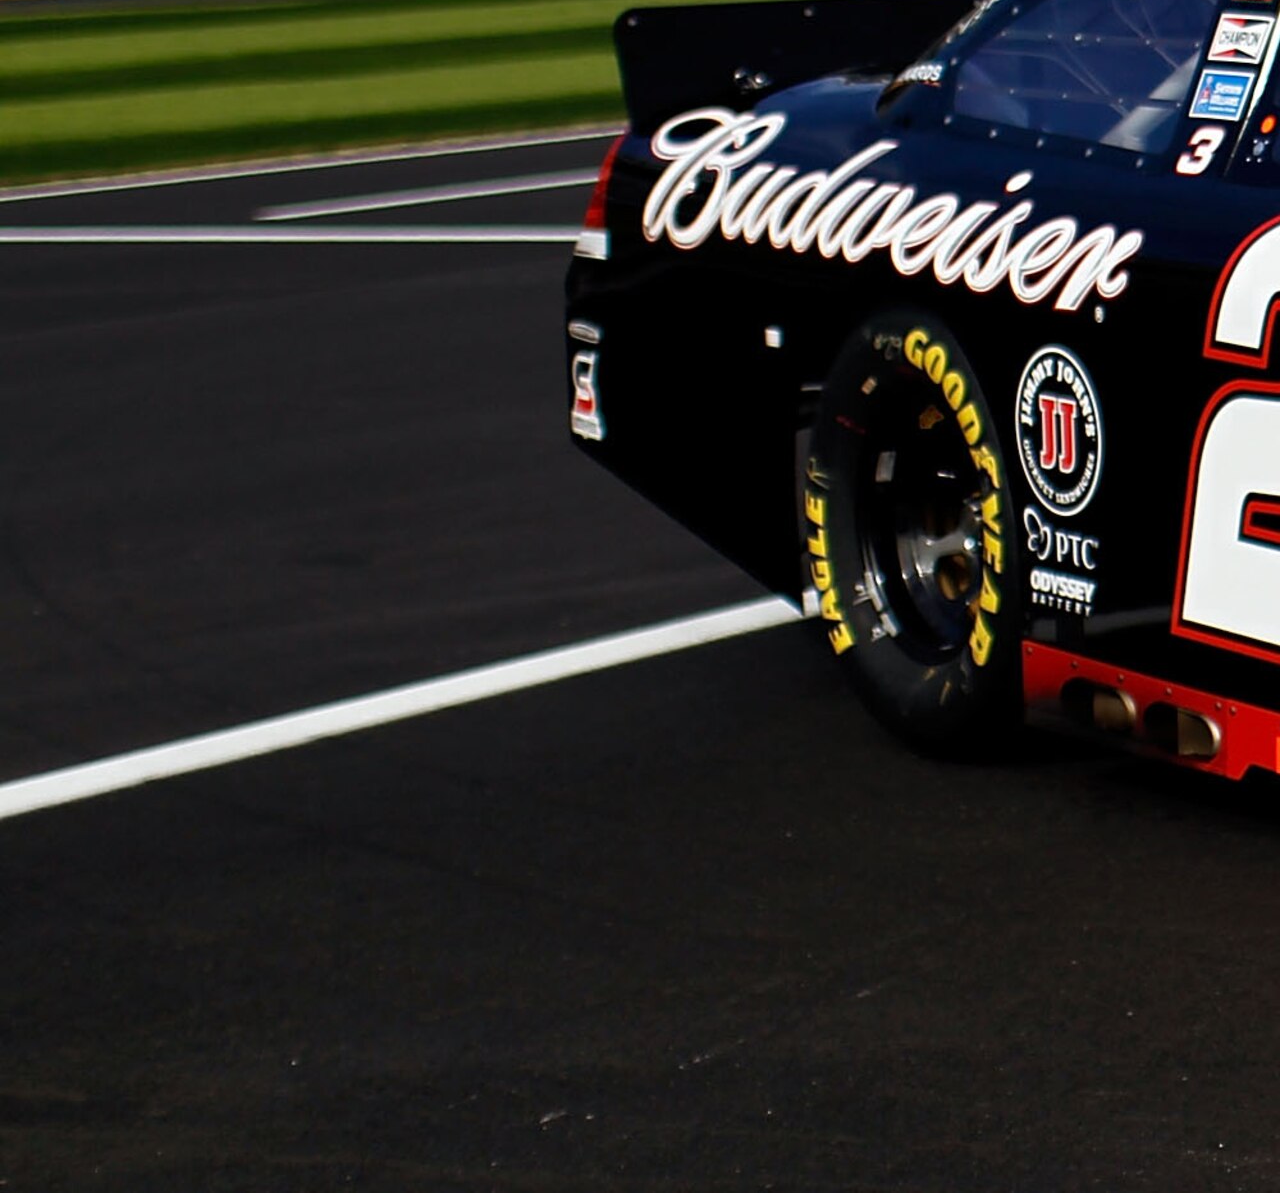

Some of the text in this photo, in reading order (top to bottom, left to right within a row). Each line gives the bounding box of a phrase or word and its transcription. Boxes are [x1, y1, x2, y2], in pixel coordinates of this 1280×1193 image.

[1219, 30, 1262, 47] CHAMPION
[1175, 125, 1226, 175] 3
[642, 108, 1143, 311] Budweiser
[1021, 359, 1053, 427] JIMMY
[1038, 394, 1077, 474] JJ
[805, 491, 855, 655] EAGLE
[1055, 530, 1098, 570] PTC
[1030, 569, 1097, 603] ODYSSEY
[1031, 592, 1093, 618] BATTERY
